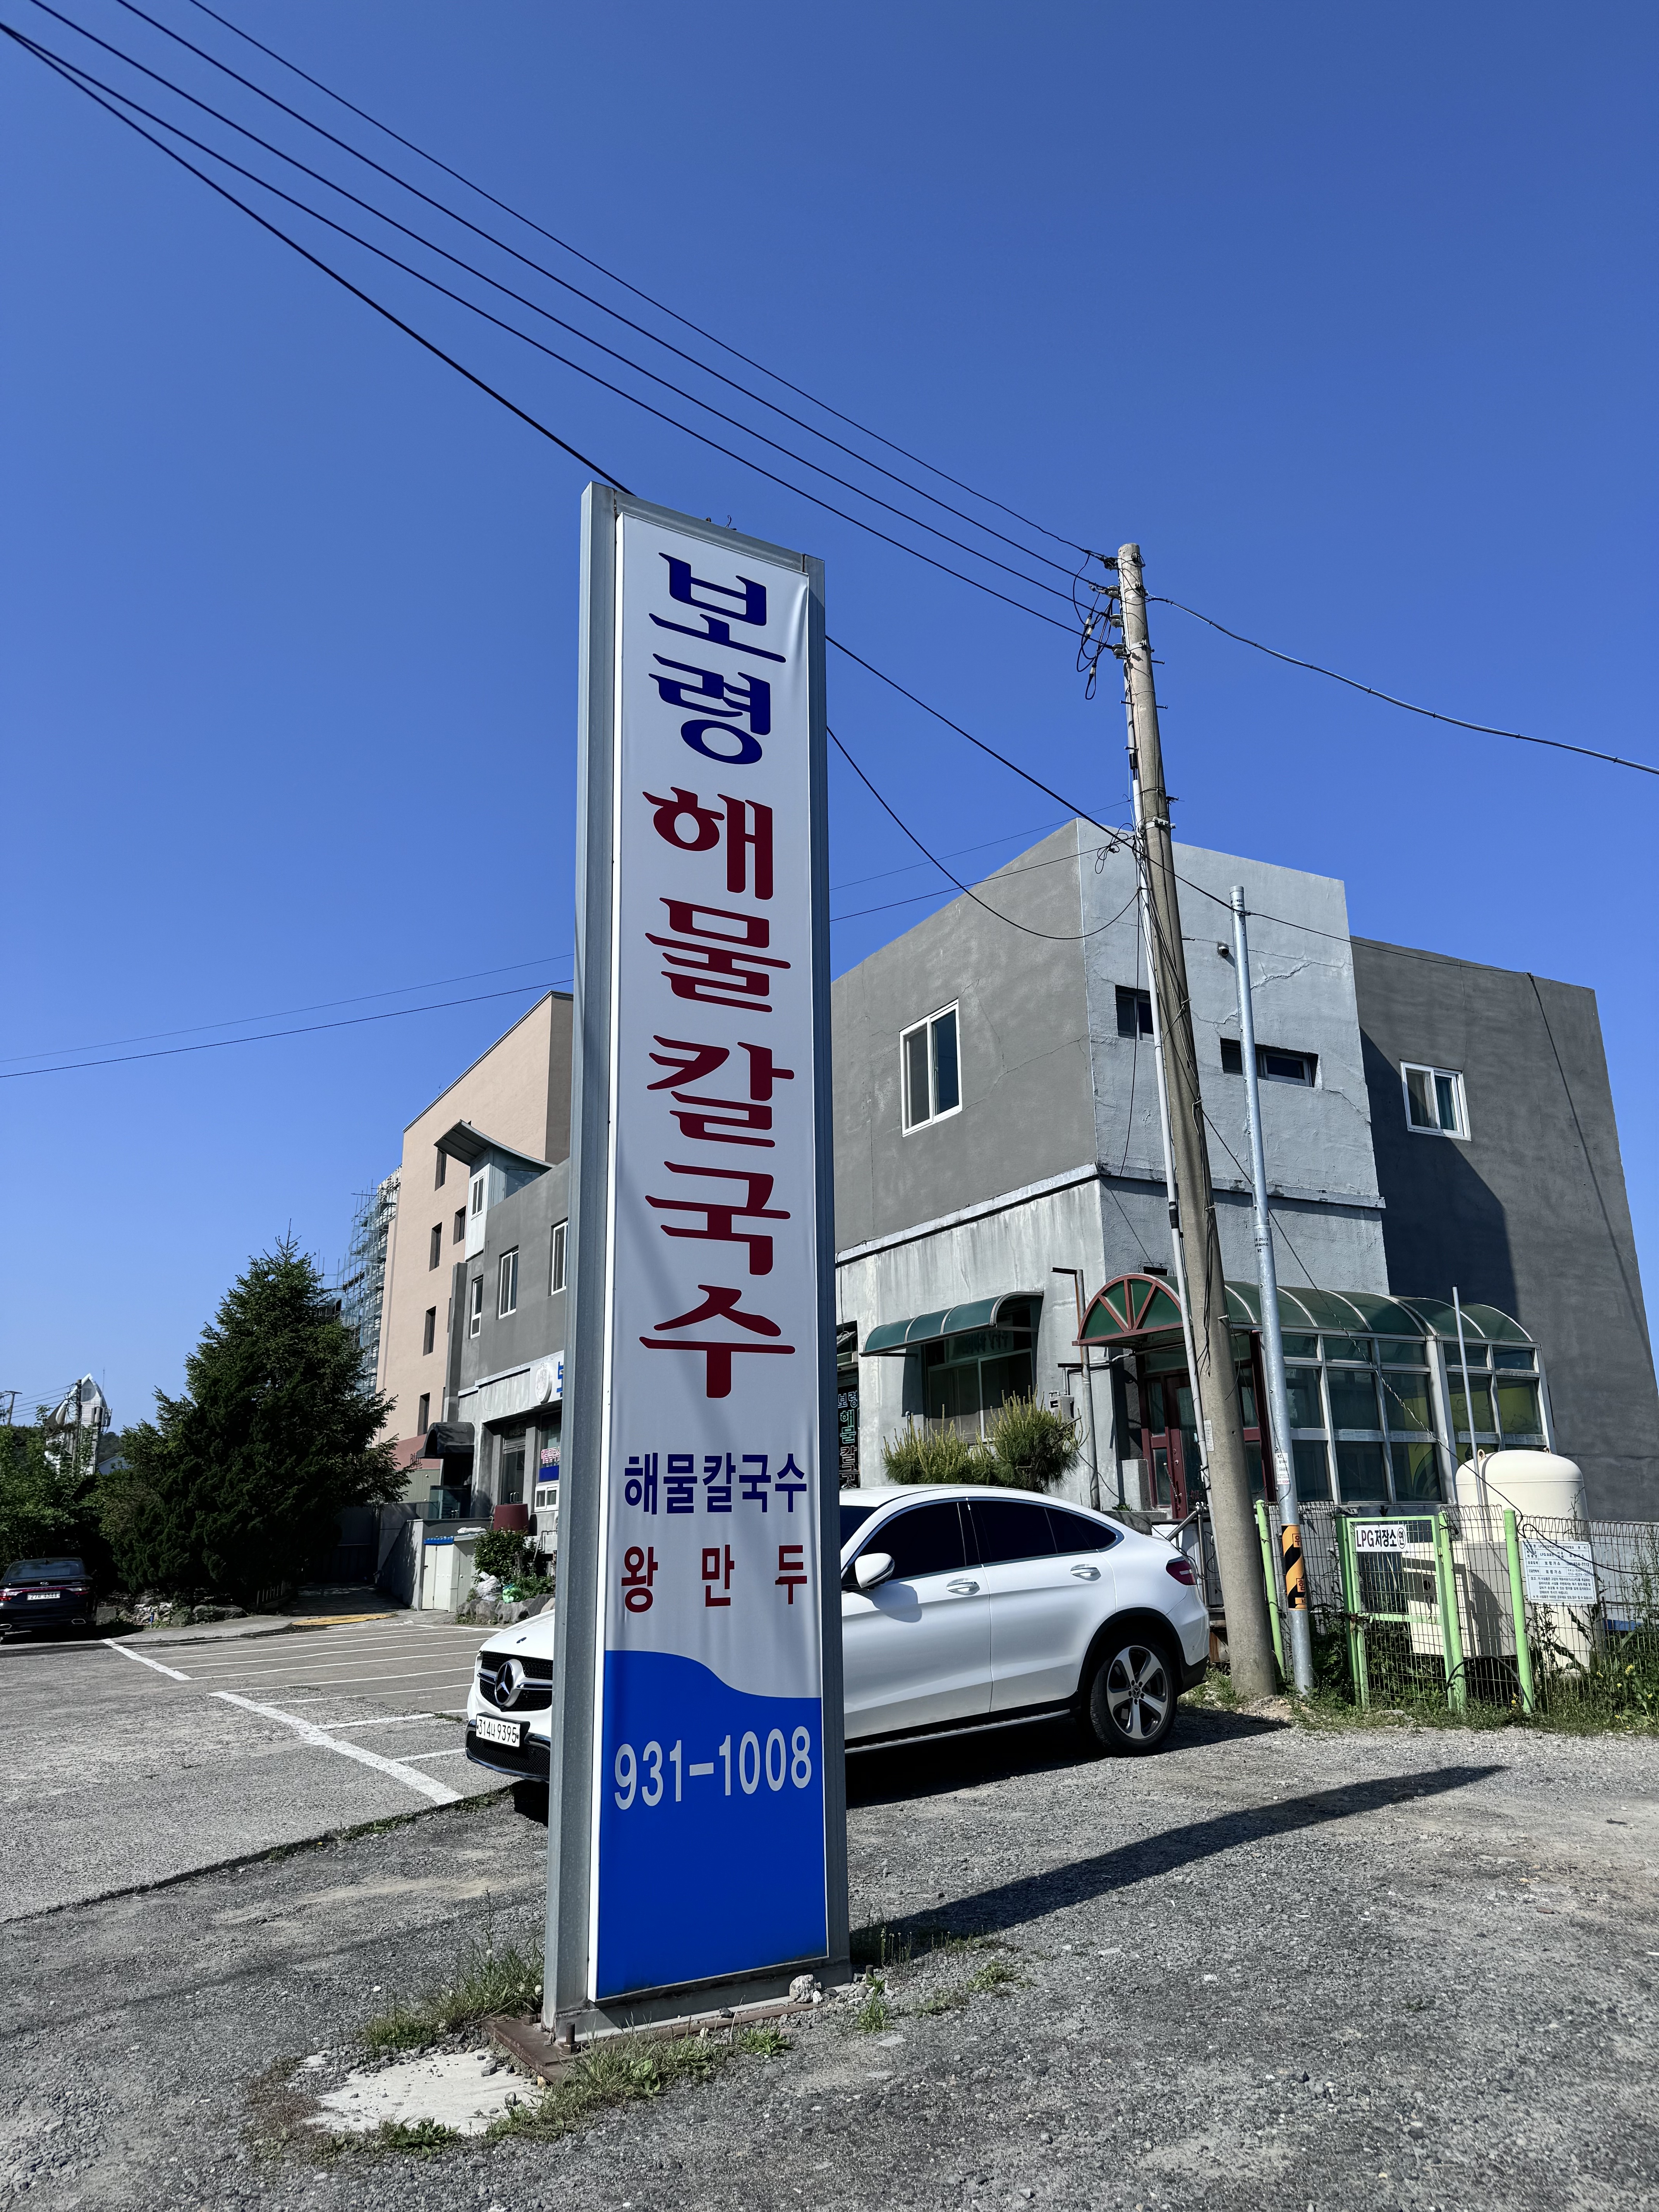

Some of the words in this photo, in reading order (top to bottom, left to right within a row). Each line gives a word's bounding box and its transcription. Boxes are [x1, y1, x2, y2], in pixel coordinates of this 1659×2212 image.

[648, 552, 786, 764] 보령
[639, 787, 795, 1398] 해물칼국수
[838, 1391, 857, 1408] 보령
[624, 1452, 807, 1515] 해물칼국수
[1356, 1529, 1397, 1547] LPG저장소
[497, 1724, 517, 1743] 9395
[615, 1726, 812, 1810] 931-1008
